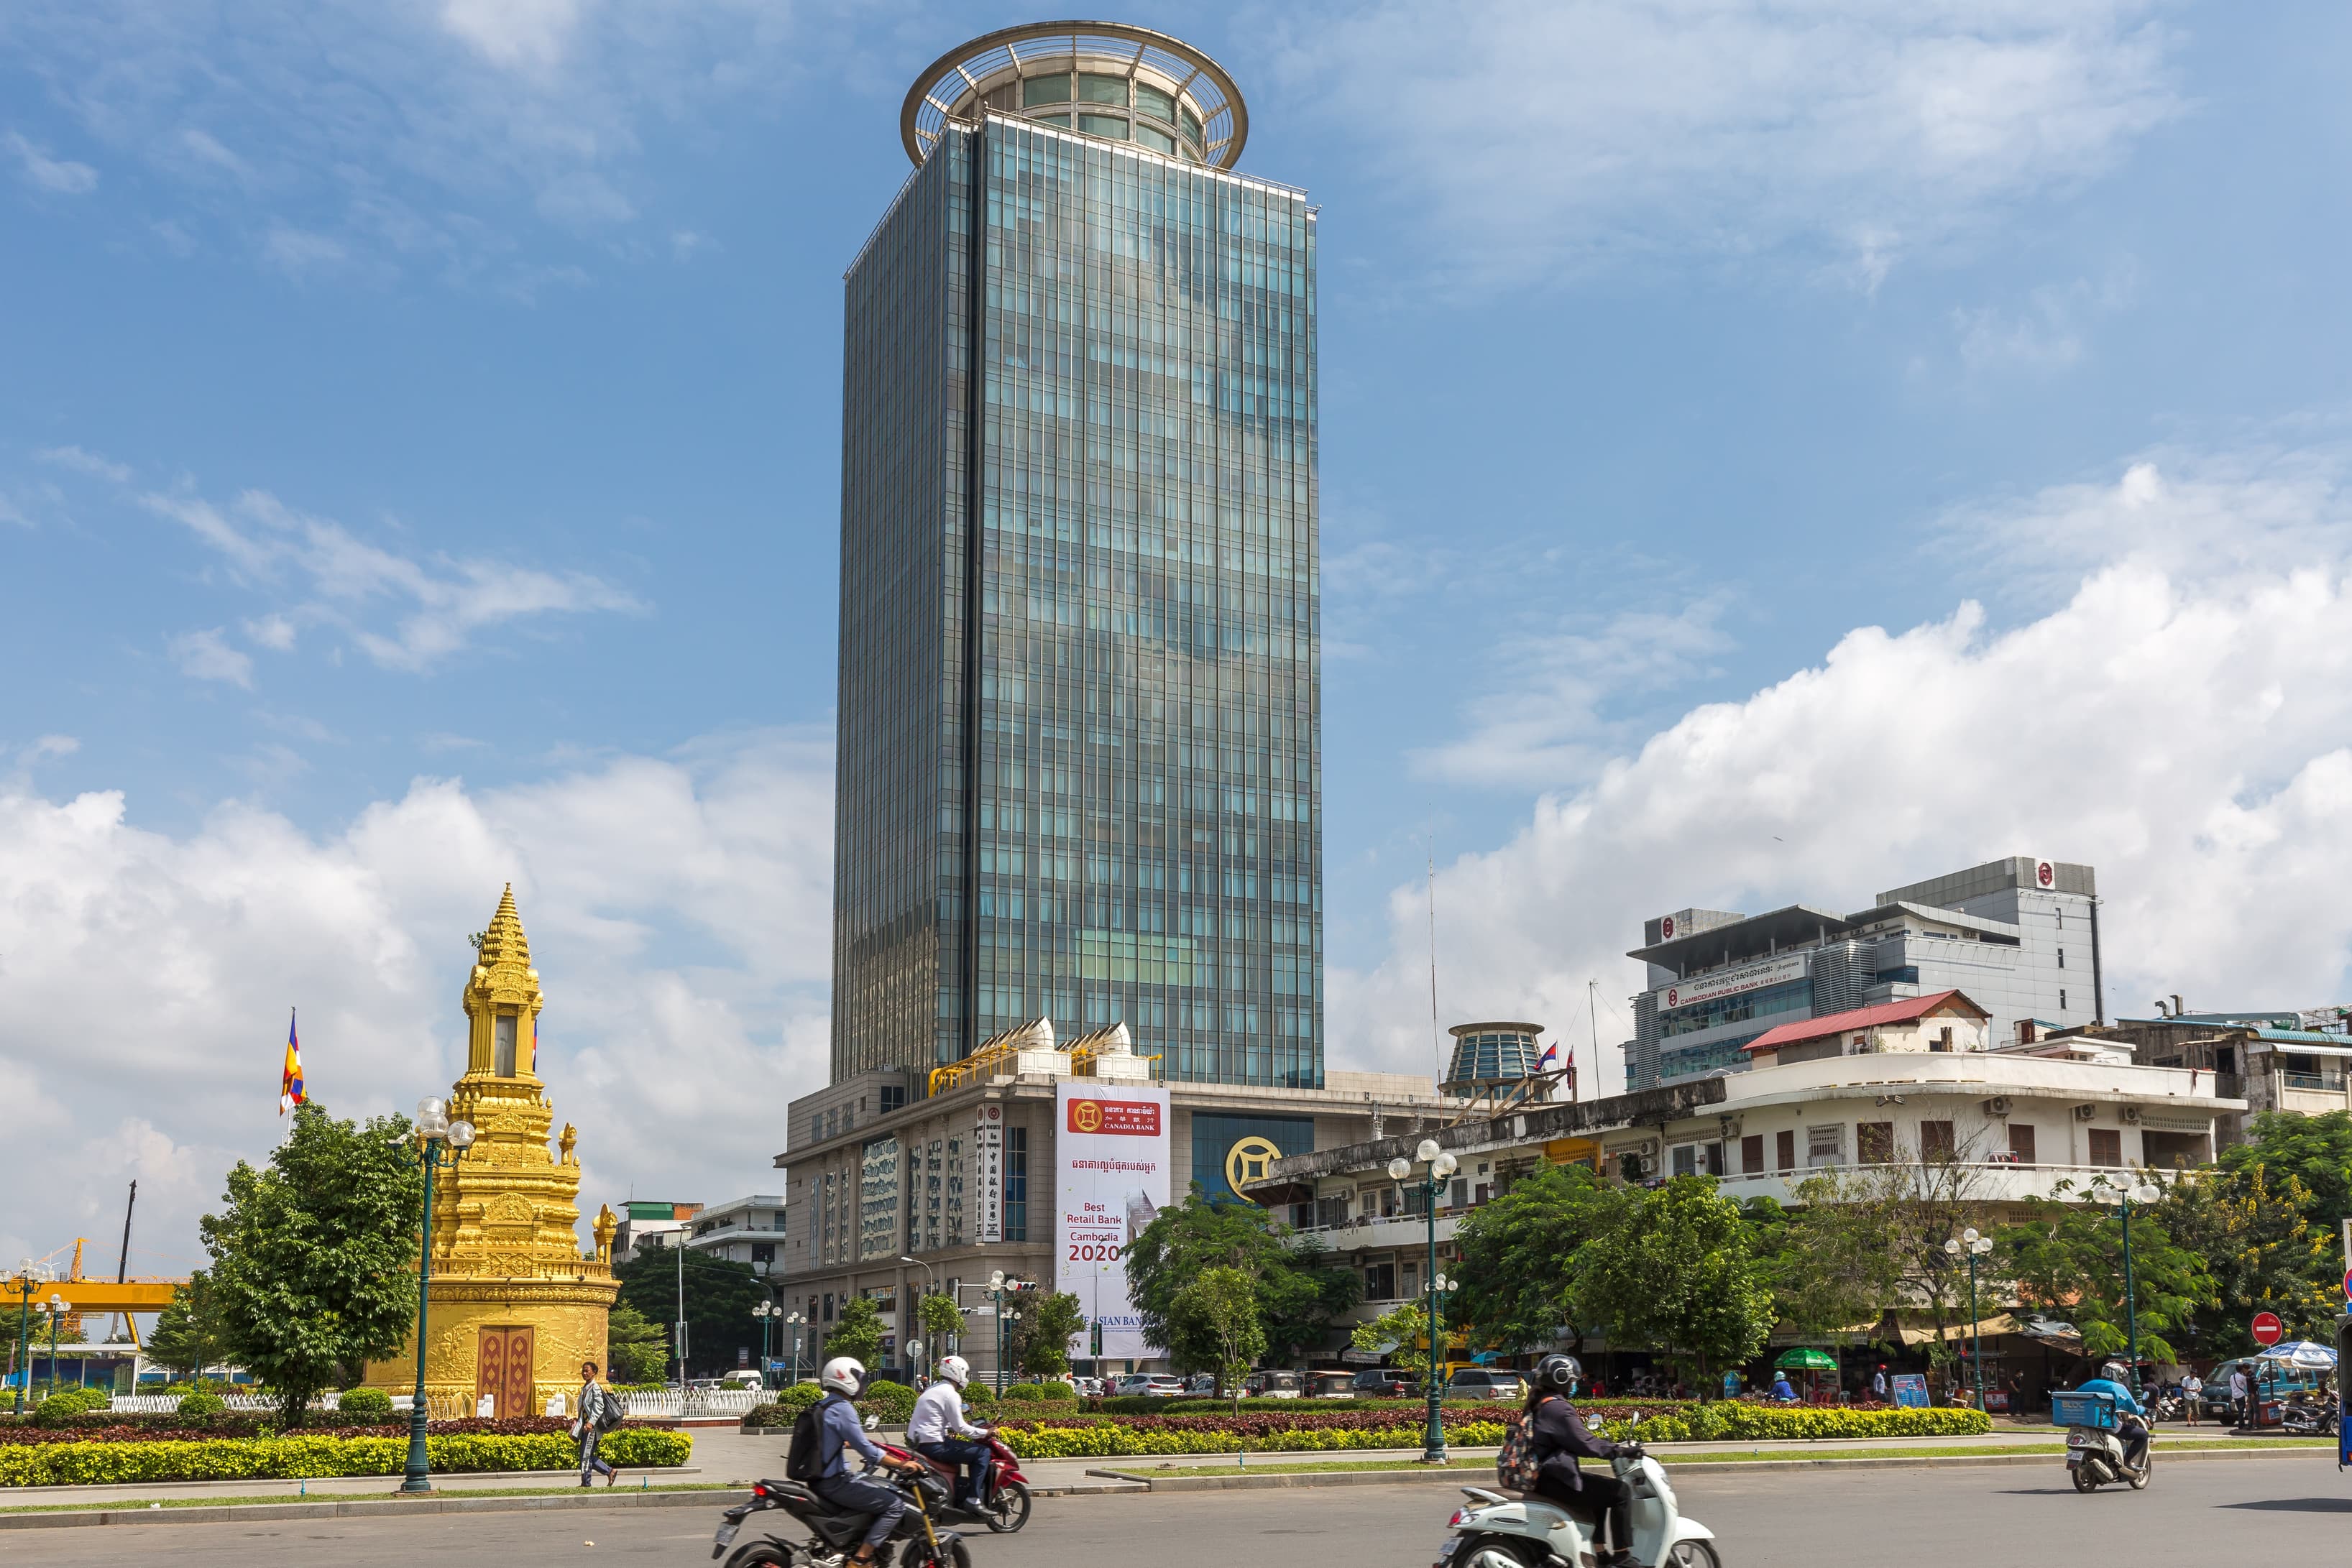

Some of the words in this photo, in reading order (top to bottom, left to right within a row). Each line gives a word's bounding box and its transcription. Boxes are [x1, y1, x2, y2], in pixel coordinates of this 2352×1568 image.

[1680, 991, 1717, 1005] CAMBODIAN
[1717, 985, 1740, 996] PUBLIC
[1740, 980, 1758, 990] BANK
[1084, 1203, 1105, 1212] Best
[1067, 1214, 1094, 1224] Retail
[1098, 1215, 1122, 1224] Bank
[1070, 1232, 1118, 1242] Cambodia
[1069, 1245, 1121, 1262] 2020
[1091, 1316, 1121, 1326] SIAN
